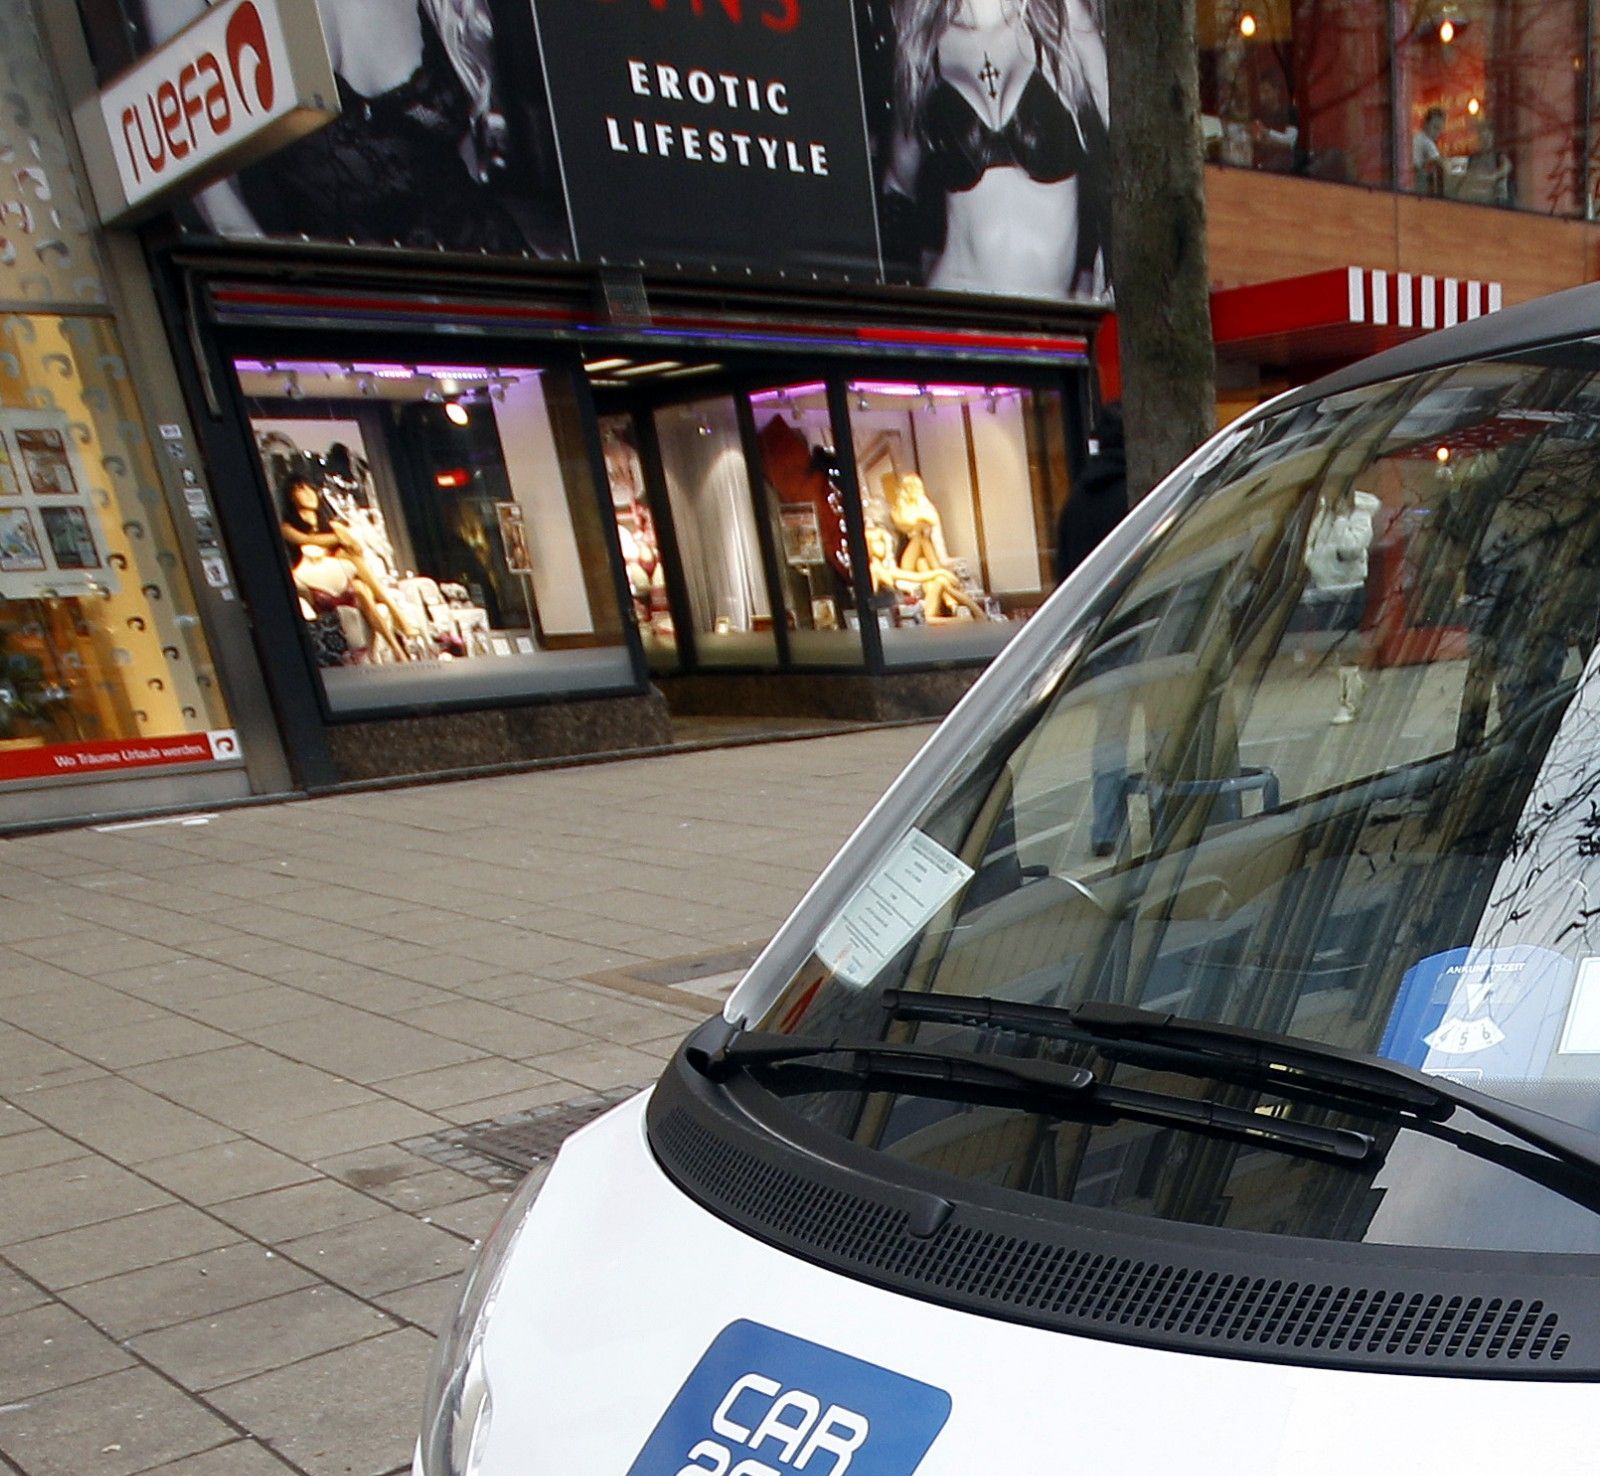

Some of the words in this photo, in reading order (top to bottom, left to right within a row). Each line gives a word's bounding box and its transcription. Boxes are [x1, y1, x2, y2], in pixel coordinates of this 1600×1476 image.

[626, 60, 790, 116] EROTIC
[121, 51, 231, 184] ruefa
[605, 117, 830, 176] LIFESTYLE
[53, 754, 76, 768] Wo
[78, 752, 121, 766] Träume
[121, 746, 161, 762] Urlaub
[1446, 962, 1526, 975] ANKUNFTSZEIT
[1459, 1031, 1469, 1046] 5
[1481, 1023, 1491, 1040] 6
